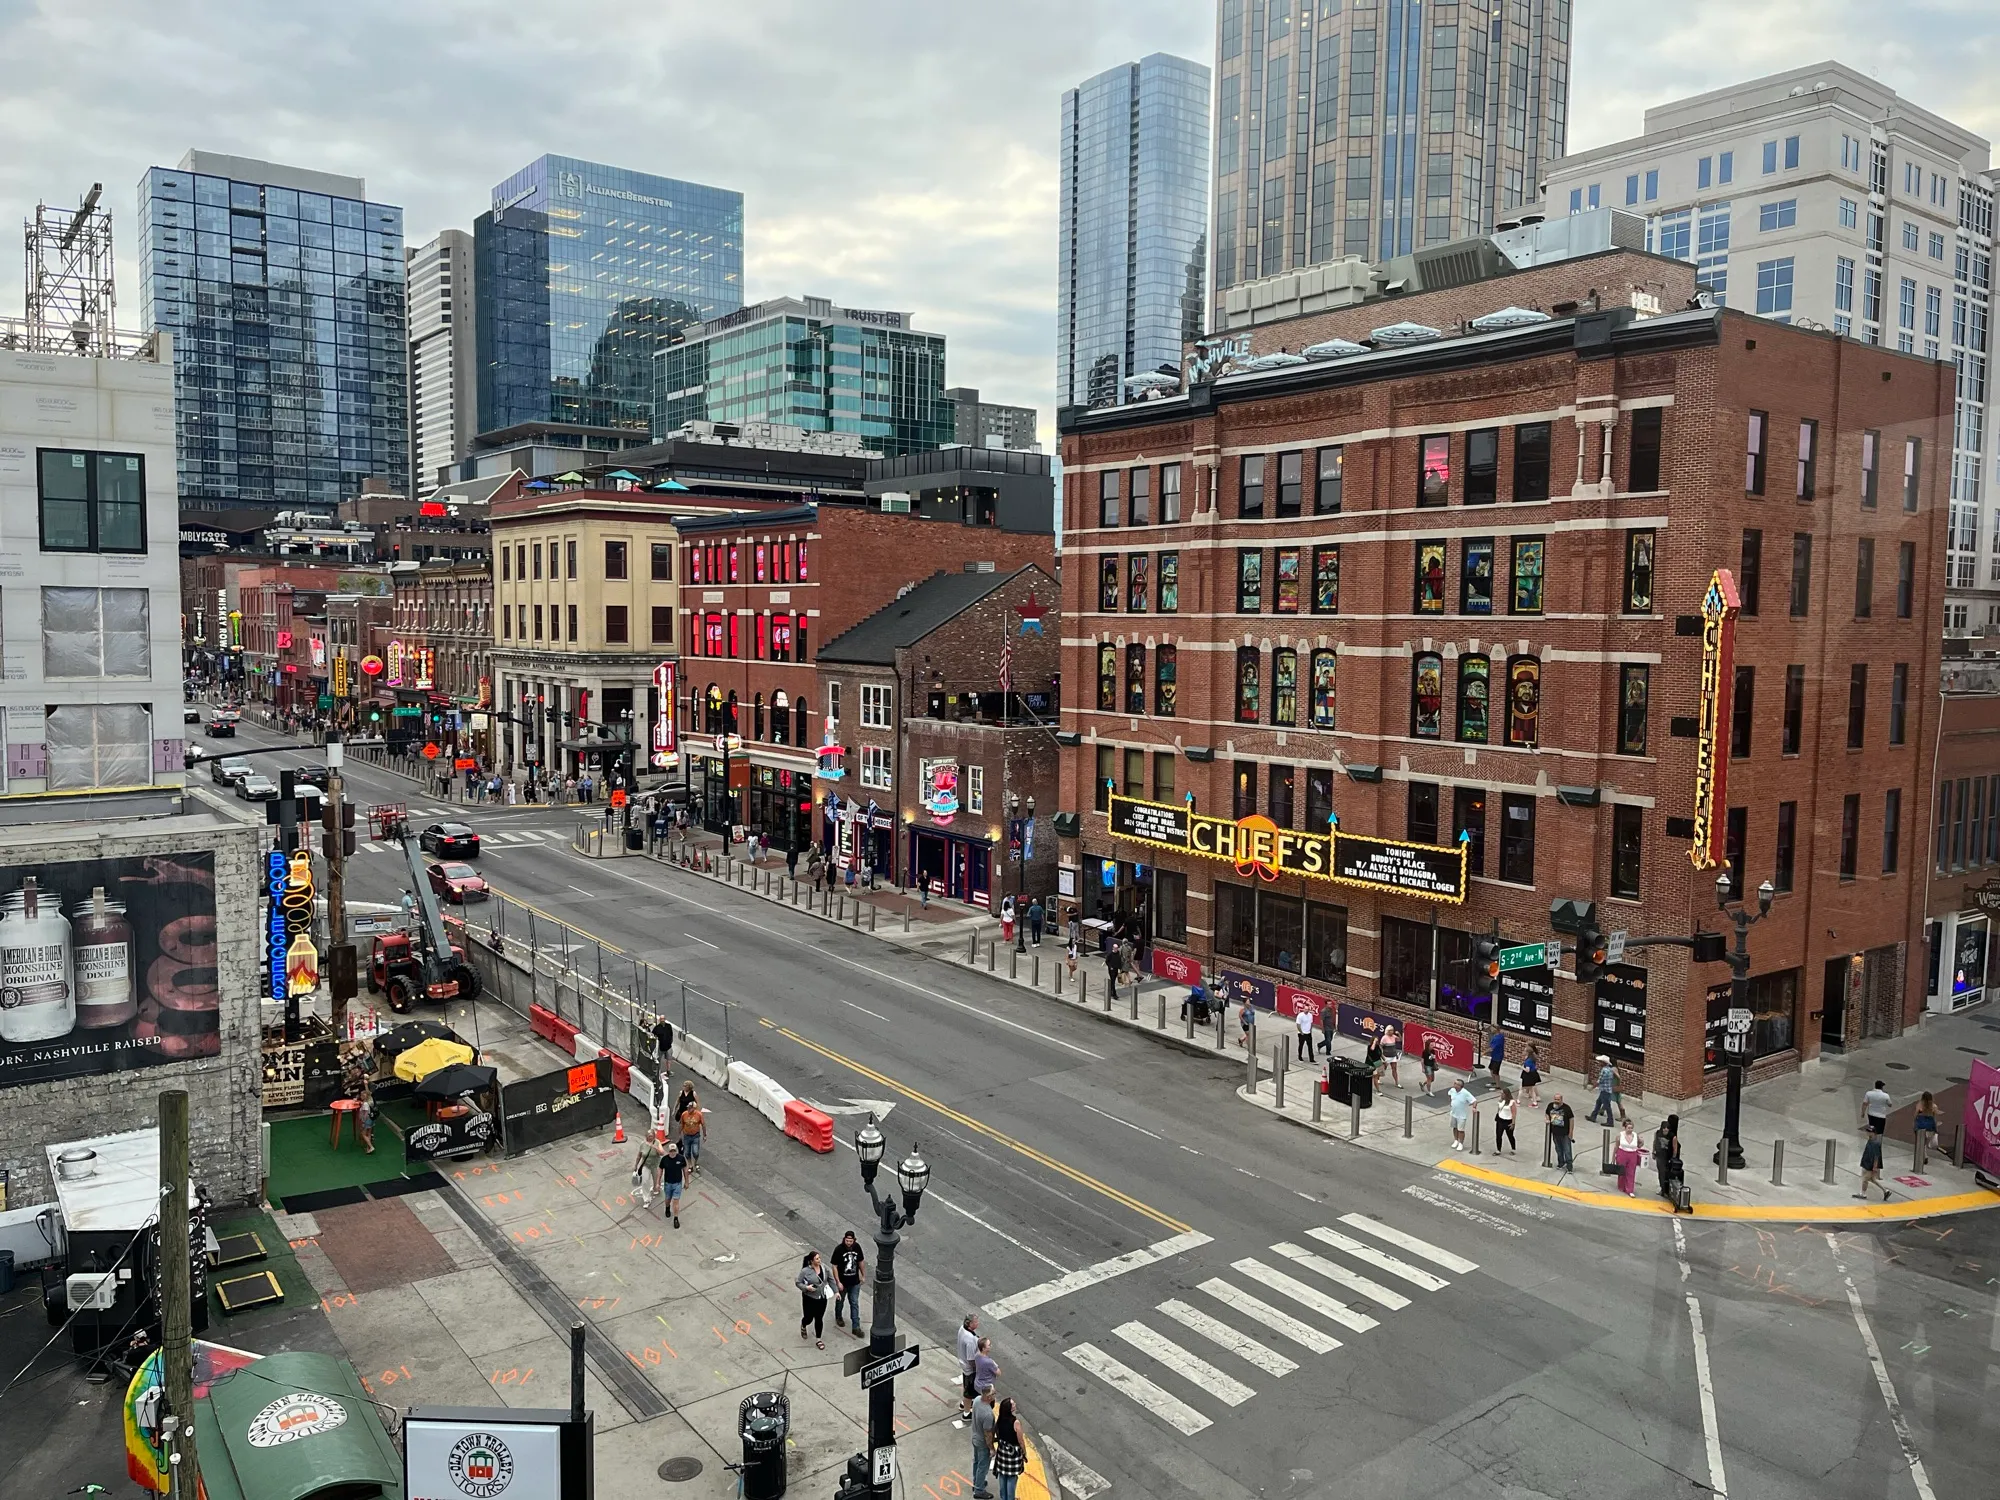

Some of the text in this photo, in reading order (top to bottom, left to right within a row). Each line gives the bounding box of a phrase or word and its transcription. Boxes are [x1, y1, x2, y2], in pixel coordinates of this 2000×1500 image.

[1631, 291, 1661, 314] HELL
[843, 308, 885, 324] TRUIST
[218, 589, 227, 626] WHISKEY
[1134, 806, 1174, 819] CONGRATULATIONS
[1136, 821, 1149, 830] SPIRIT
[1192, 822, 1322, 872] CHIEF'S
[1386, 848, 1416, 860] TONIGHT
[1356, 860, 1437, 880] W/ ALYSSA BONAGURA
[1371, 854, 1426, 870] BUDDY'S PLACE
[1344, 867, 1358, 876] BEN
[1359, 870, 1390, 882] DANAHER
[1400, 876, 1430, 888] MICHAEL
[1432, 882, 1454, 892] LOGEN
[269, 853, 287, 1000] BOOTLEGGERS
[3, 944, 62, 964] AMERICAN BORN
[75, 945, 126, 962] AMERICAN BORN
[1549, 950, 1560, 958] WAY
[1610, 942, 1622, 950] BLOCK
[4, 961, 63, 974] MOONSHINE
[76, 960, 126, 972] MOONSHINE
[6, 973, 60, 984] ORIGINAL
[86, 970, 114, 980] DIXIE
[288, 979, 316, 998] Inn
[1233, 980, 1260, 994] CHIEF'S
[1354, 1016, 1385, 1032] CHIEF'S
[1502, 1020, 1526, 1030] SiriusXM
[1729, 1021, 1738, 1030] OK
[34, 1043, 110, 1062] NASHVILLE
[114, 1036, 166, 1050] RAISED.
[570, 1074, 594, 1085] DETOUR
[866, 1358, 902, 1381] ONE WAY
[254, 1396, 291, 1424] TOWN
[268, 1420, 339, 1445] TOURS
[450, 1435, 512, 1474] OLD TOWN TROLLEY
[878, 1446, 893, 1454] CROSS
[877, 1474, 892, 1482] SIGNAL
[458, 1476, 504, 1497] TOURS
